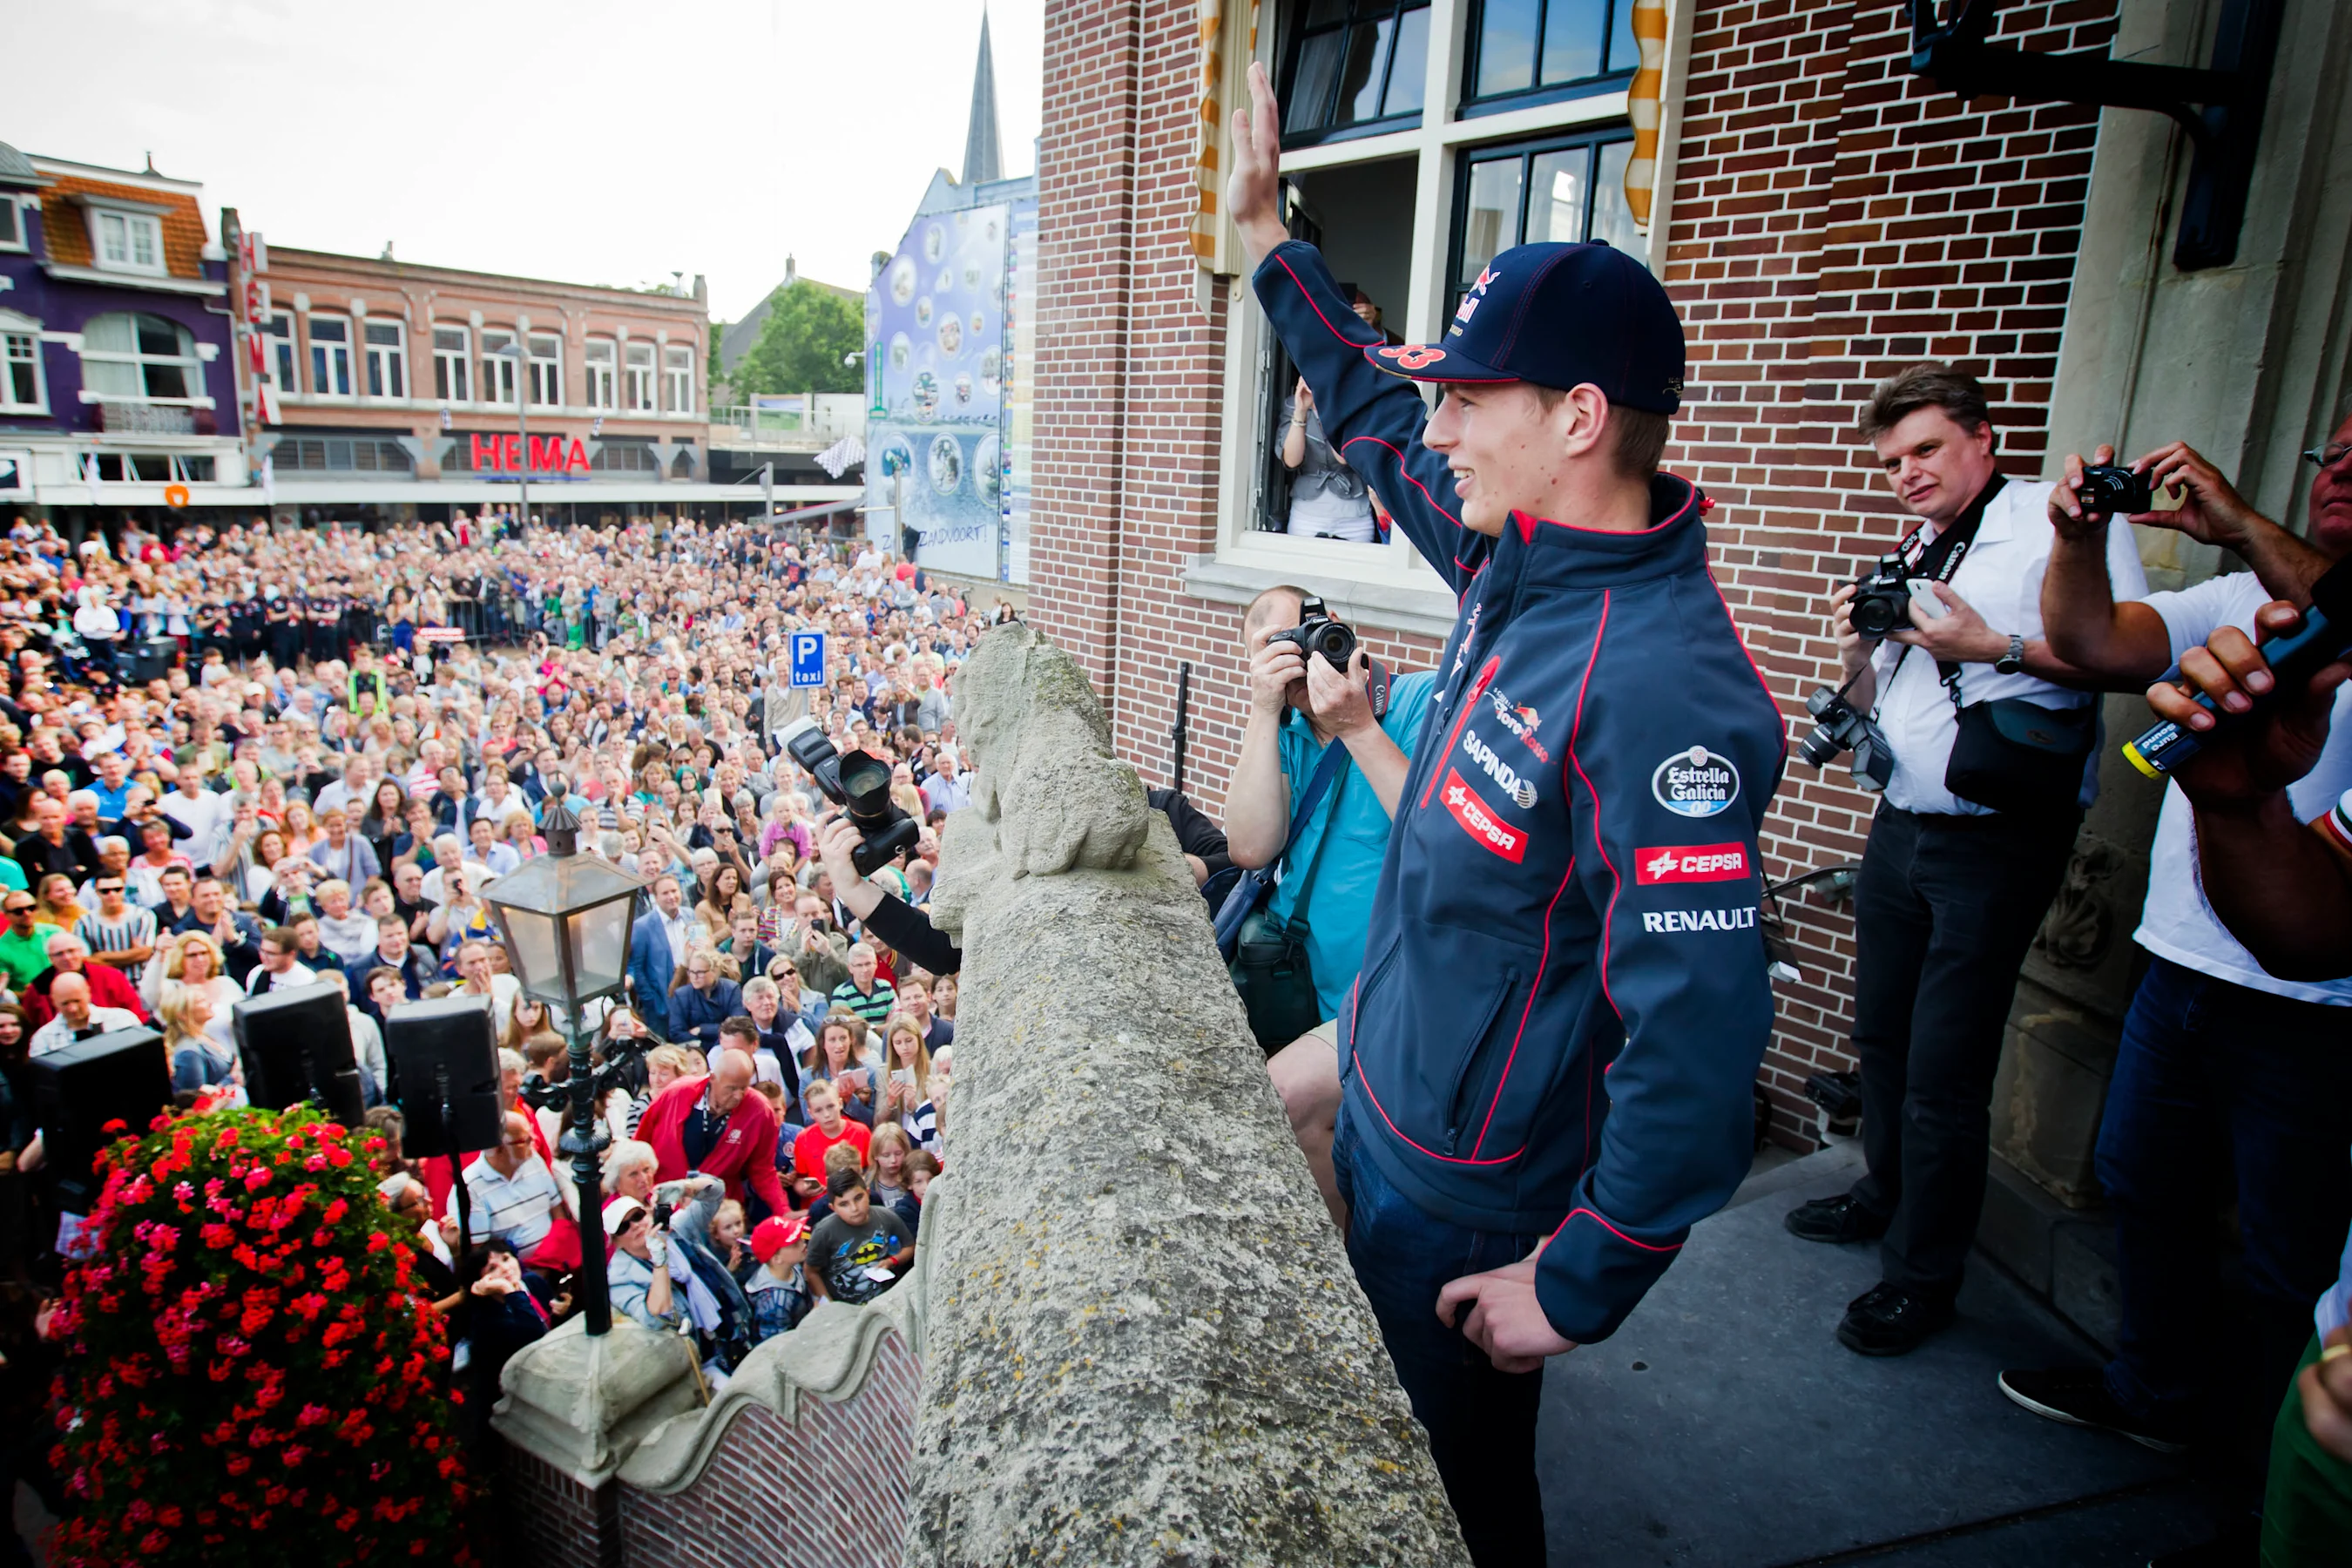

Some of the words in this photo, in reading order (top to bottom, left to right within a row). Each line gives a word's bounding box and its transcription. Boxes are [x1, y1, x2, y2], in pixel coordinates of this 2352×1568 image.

[239, 232, 273, 423] HEMA
[1378, 344, 1446, 369] 33
[470, 433, 591, 471] HEMA
[1937, 542, 1966, 580] Canon
[798, 637, 817, 665] P
[795, 671, 821, 683] taxi
[2141, 723, 2176, 749] Sound
[2151, 732, 2178, 751] Euro
[1463, 730, 1521, 801] SAPINDA
[1667, 767, 1729, 784] Estrella
[1670, 784, 1727, 801] Galicia
[1463, 801, 1516, 850] CEPSA
[1680, 853, 1741, 873] CEPSA
[1642, 907, 1756, 933] RENAULT
